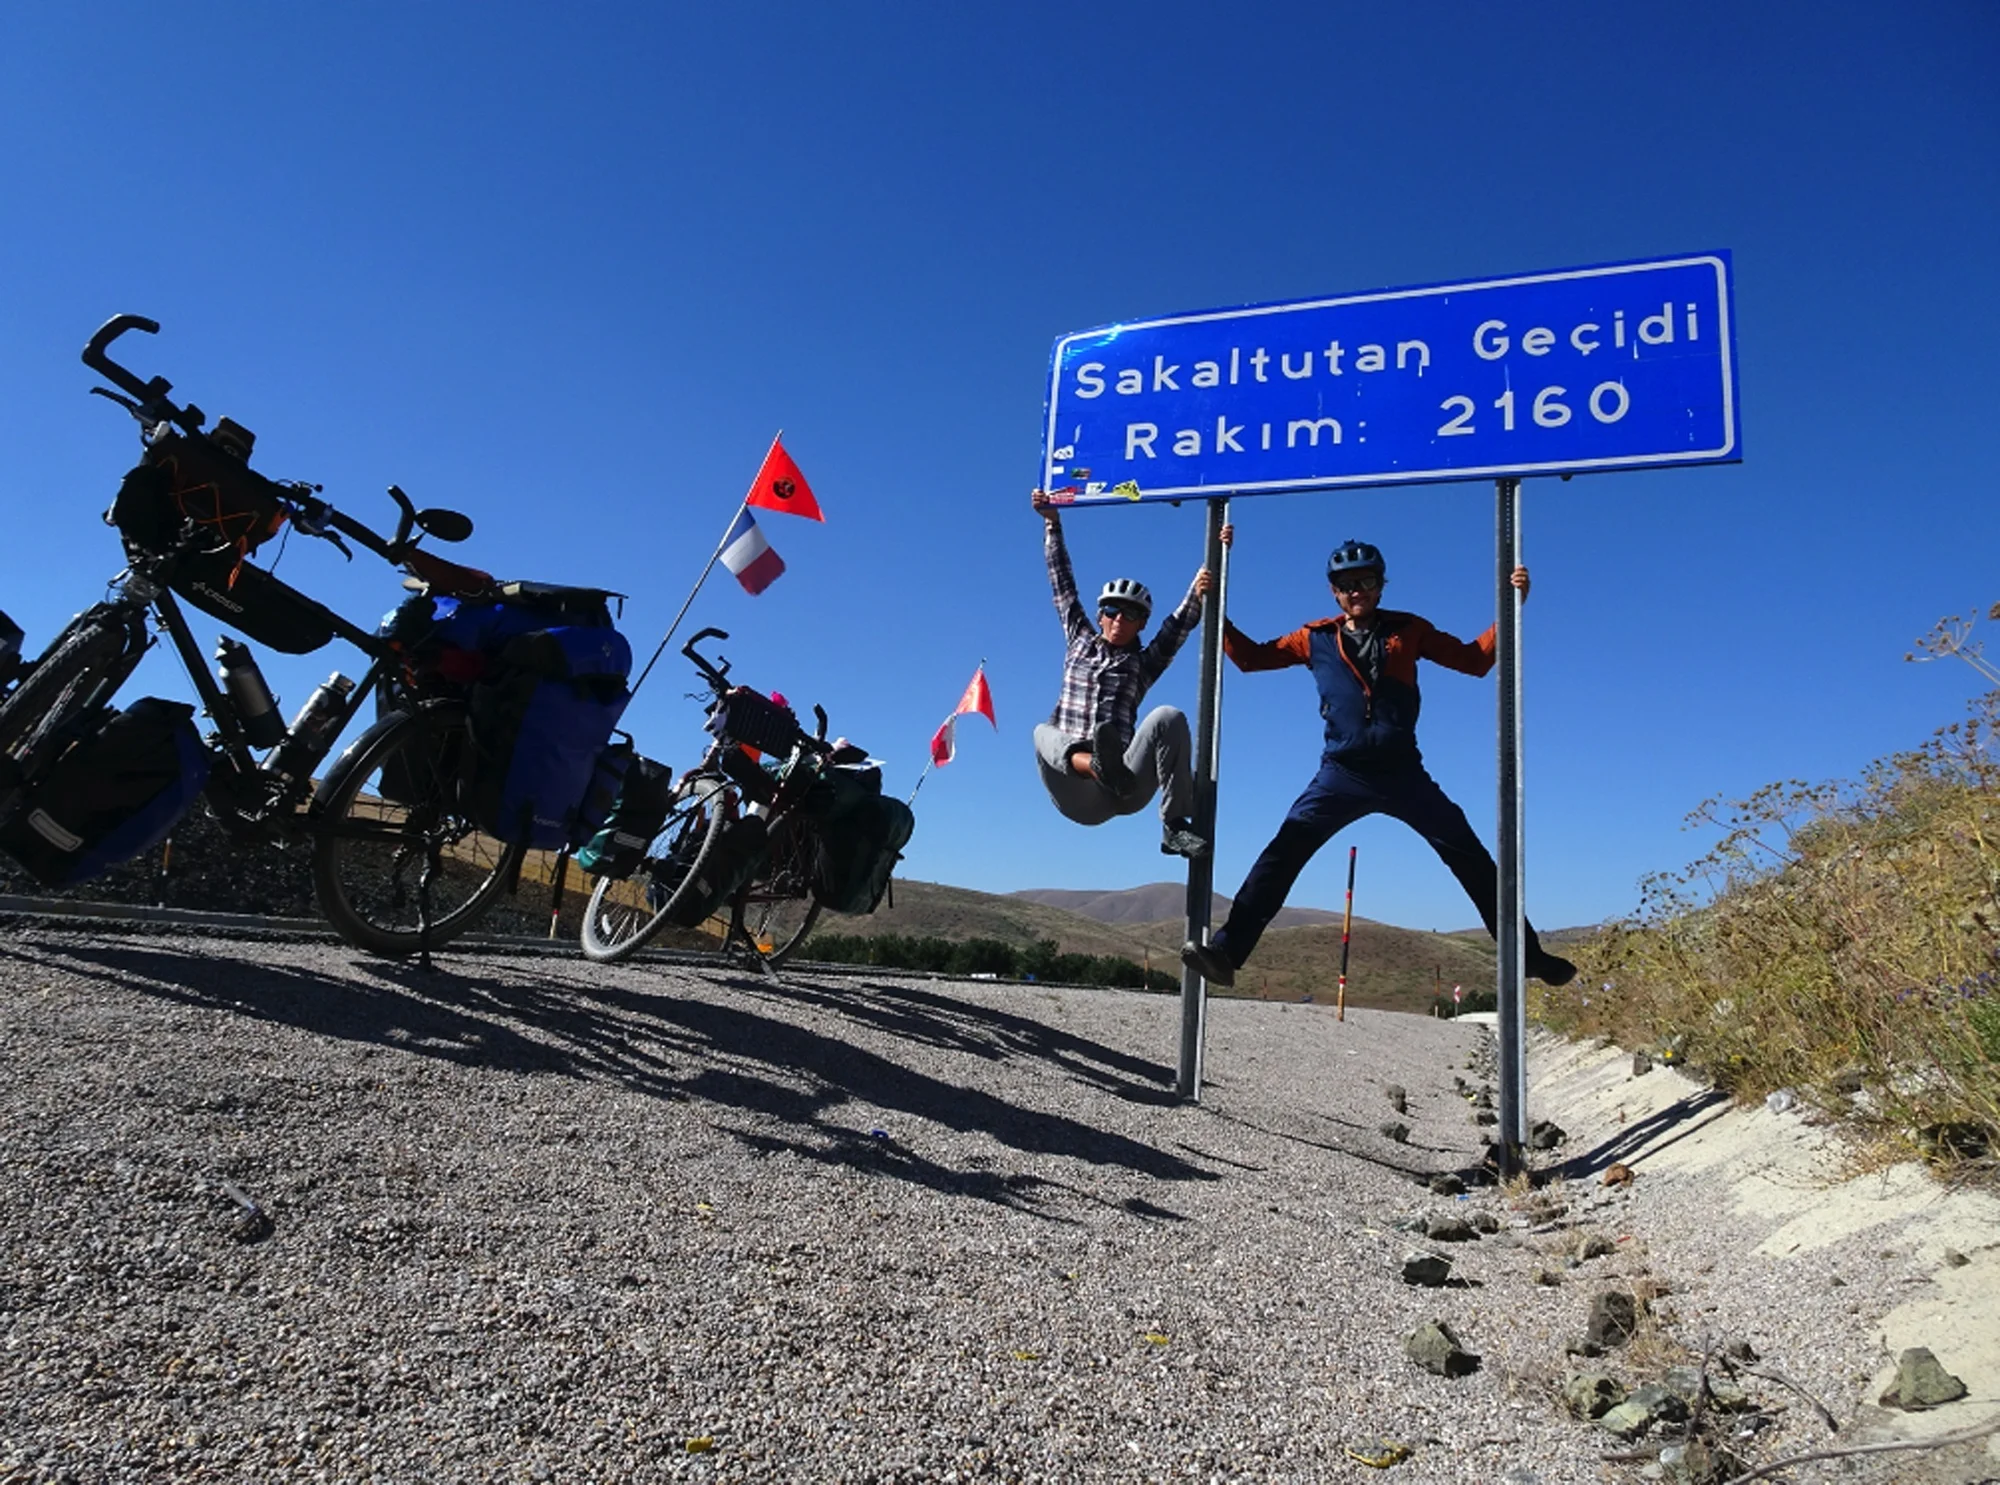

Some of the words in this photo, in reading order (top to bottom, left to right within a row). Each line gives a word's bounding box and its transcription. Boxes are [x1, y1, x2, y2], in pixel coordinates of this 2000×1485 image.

[1075, 340, 1431, 399] Sakaltutan
[1473, 302, 1700, 360] Geçidi
[1125, 415, 1367, 460] Rakım:
[1437, 381, 1631, 436] 2160
